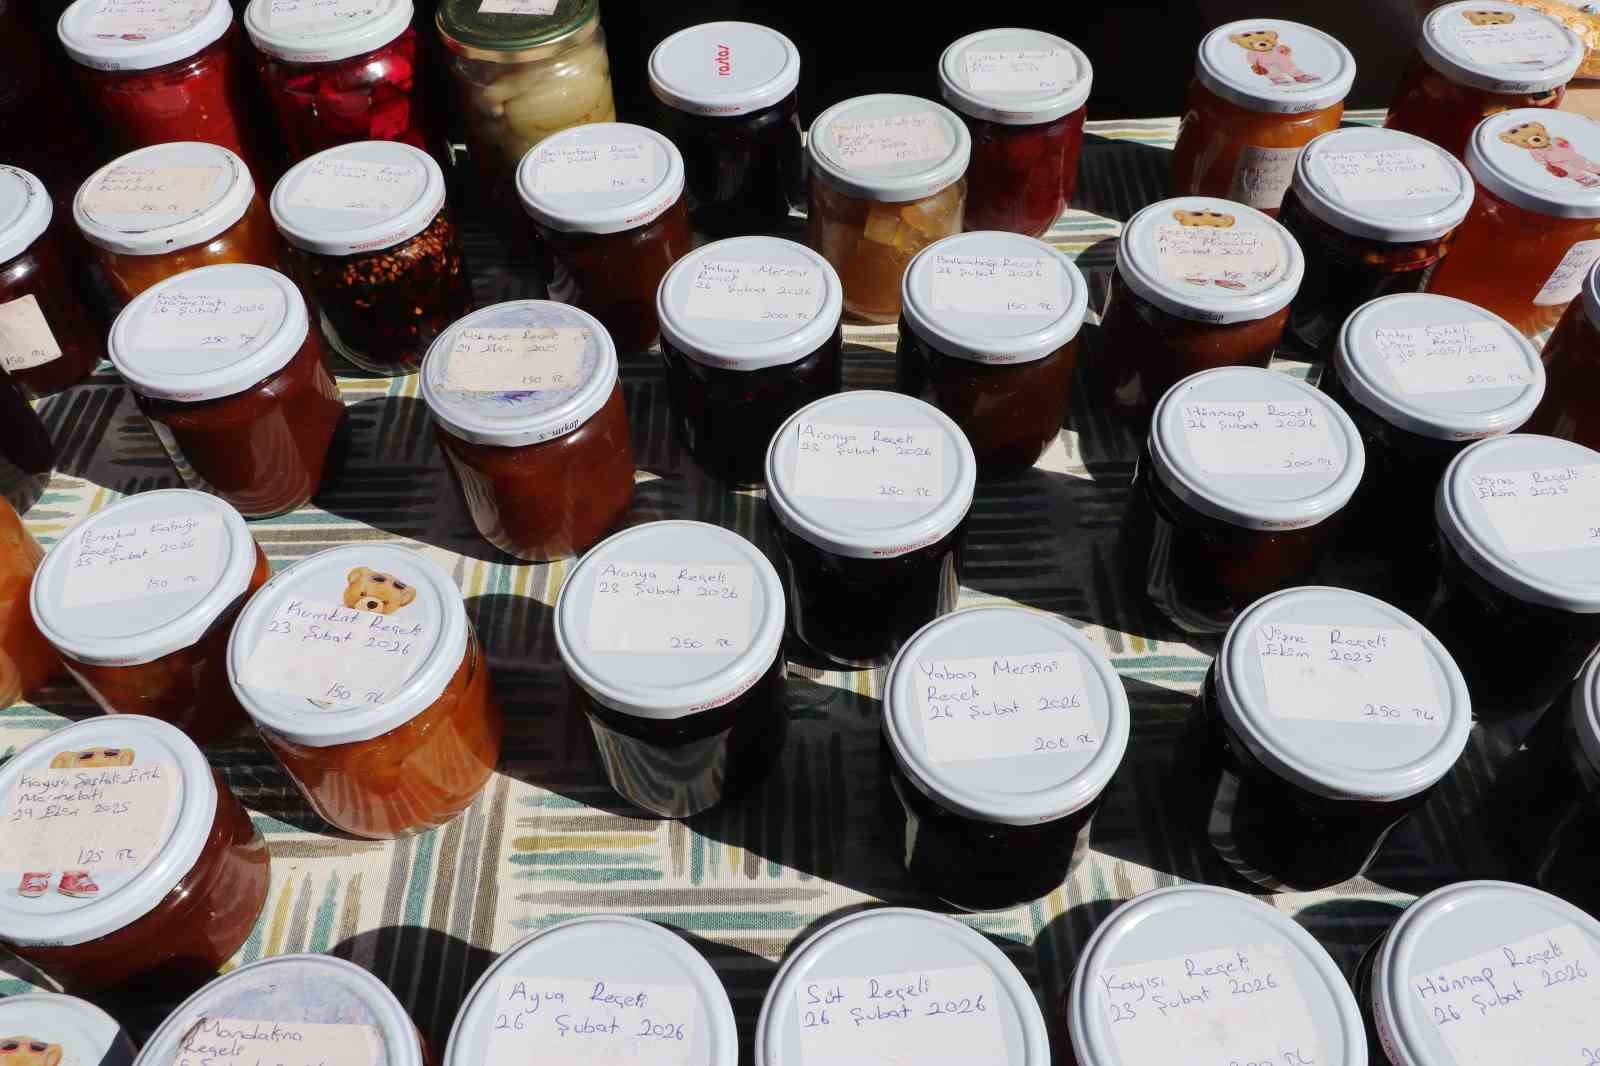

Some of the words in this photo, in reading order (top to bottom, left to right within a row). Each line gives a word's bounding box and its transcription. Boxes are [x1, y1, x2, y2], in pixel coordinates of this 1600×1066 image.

[269, 619, 293, 635] 23
[363, 636, 410, 656] 2026
[1328, 648, 1376, 665] 2025
[326, 683, 352, 700] 150
[1038, 693, 1082, 712] 2026
[1364, 703, 1402, 719] 250
[77, 847, 105, 865] 125
[807, 983, 847, 1005] Süt
[869, 974, 930, 1002] Reçeli
[1109, 1001, 1137, 1023] 23
[1228, 973, 1279, 994] 2026
[1434, 1004, 1461, 1026] 26
[1541, 959, 1588, 988] 2026
[803, 1009, 831, 1028] 26
[848, 1004, 913, 1027] Şubat
[924, 994, 987, 1017] 2026
[494, 1012, 525, 1031] 26
[554, 1013, 621, 1038] Şubat
[635, 1017, 686, 1041] 2026
